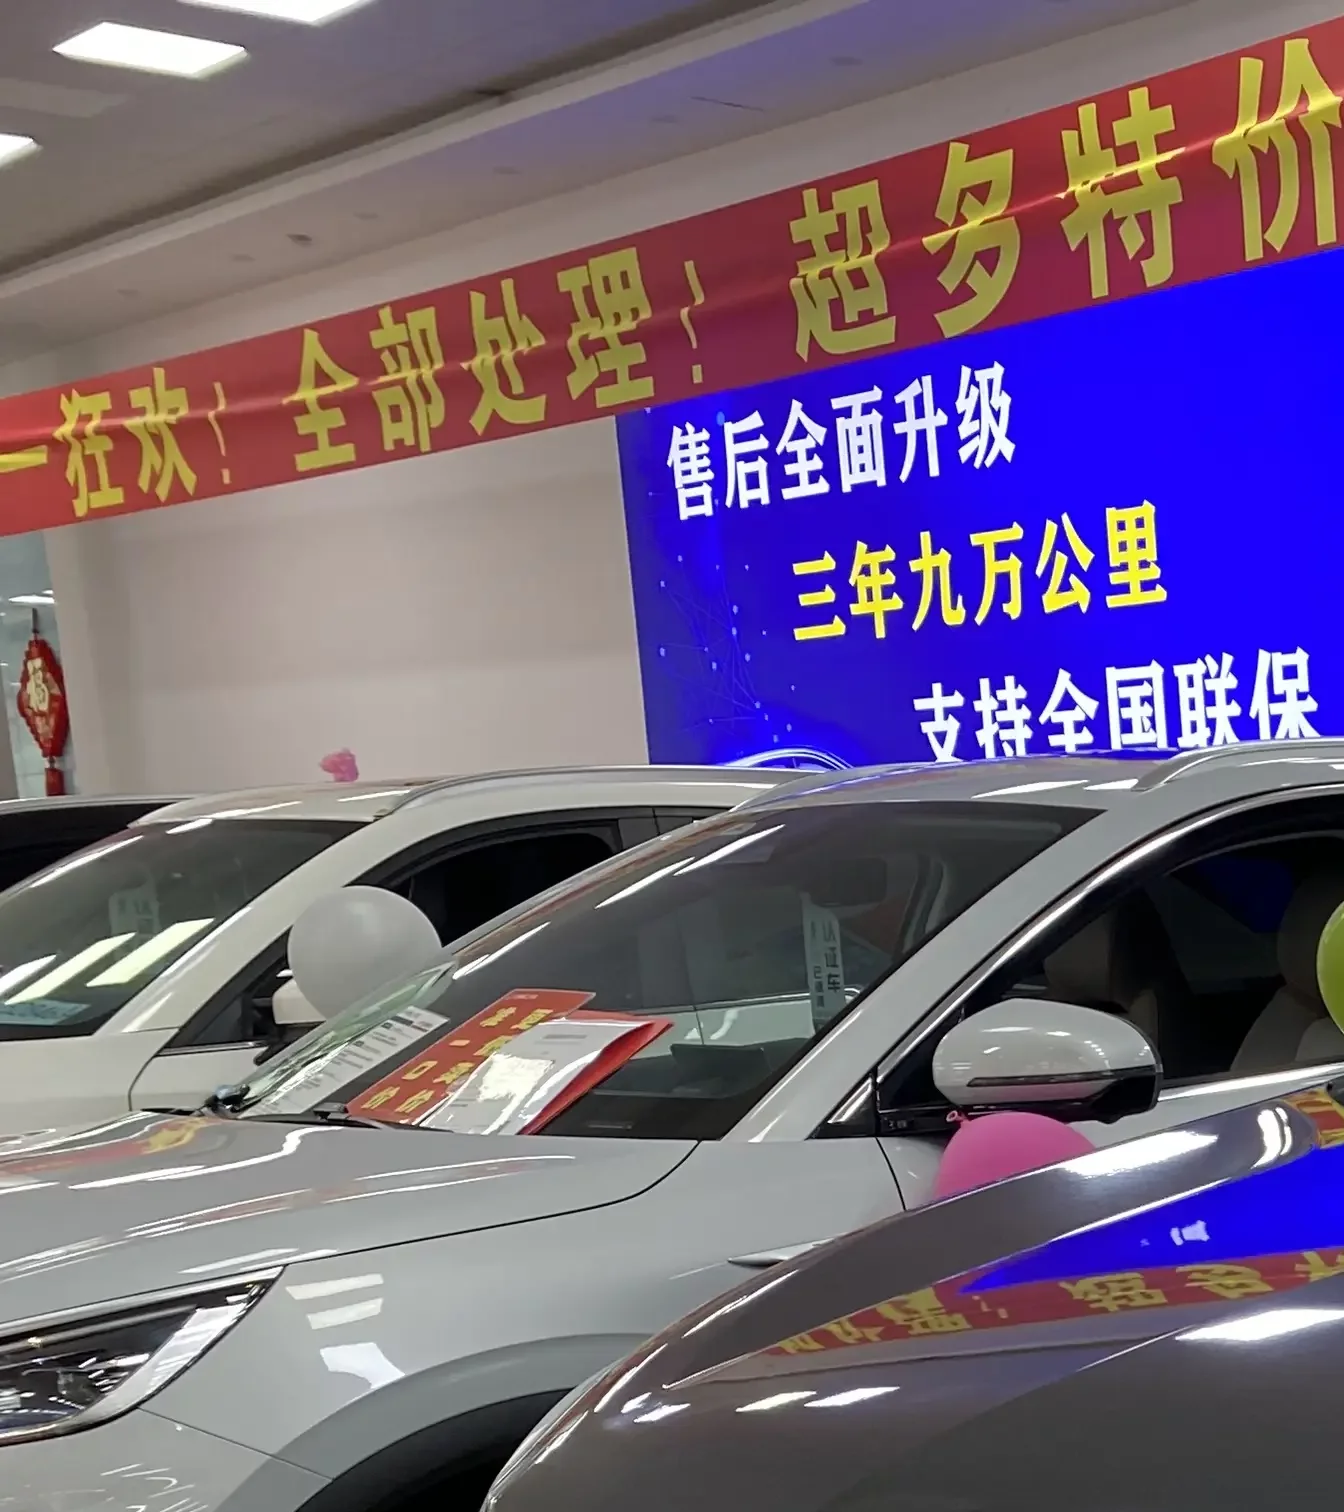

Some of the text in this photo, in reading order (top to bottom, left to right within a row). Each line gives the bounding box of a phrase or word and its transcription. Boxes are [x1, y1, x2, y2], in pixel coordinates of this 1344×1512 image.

[283, 247, 704, 473] 全部处理！
[666, 360, 1017, 522] 售后全面升级
[792, 499, 1168, 643] 三年九万公里
[912, 646, 1320, 763] 支持全国联保
